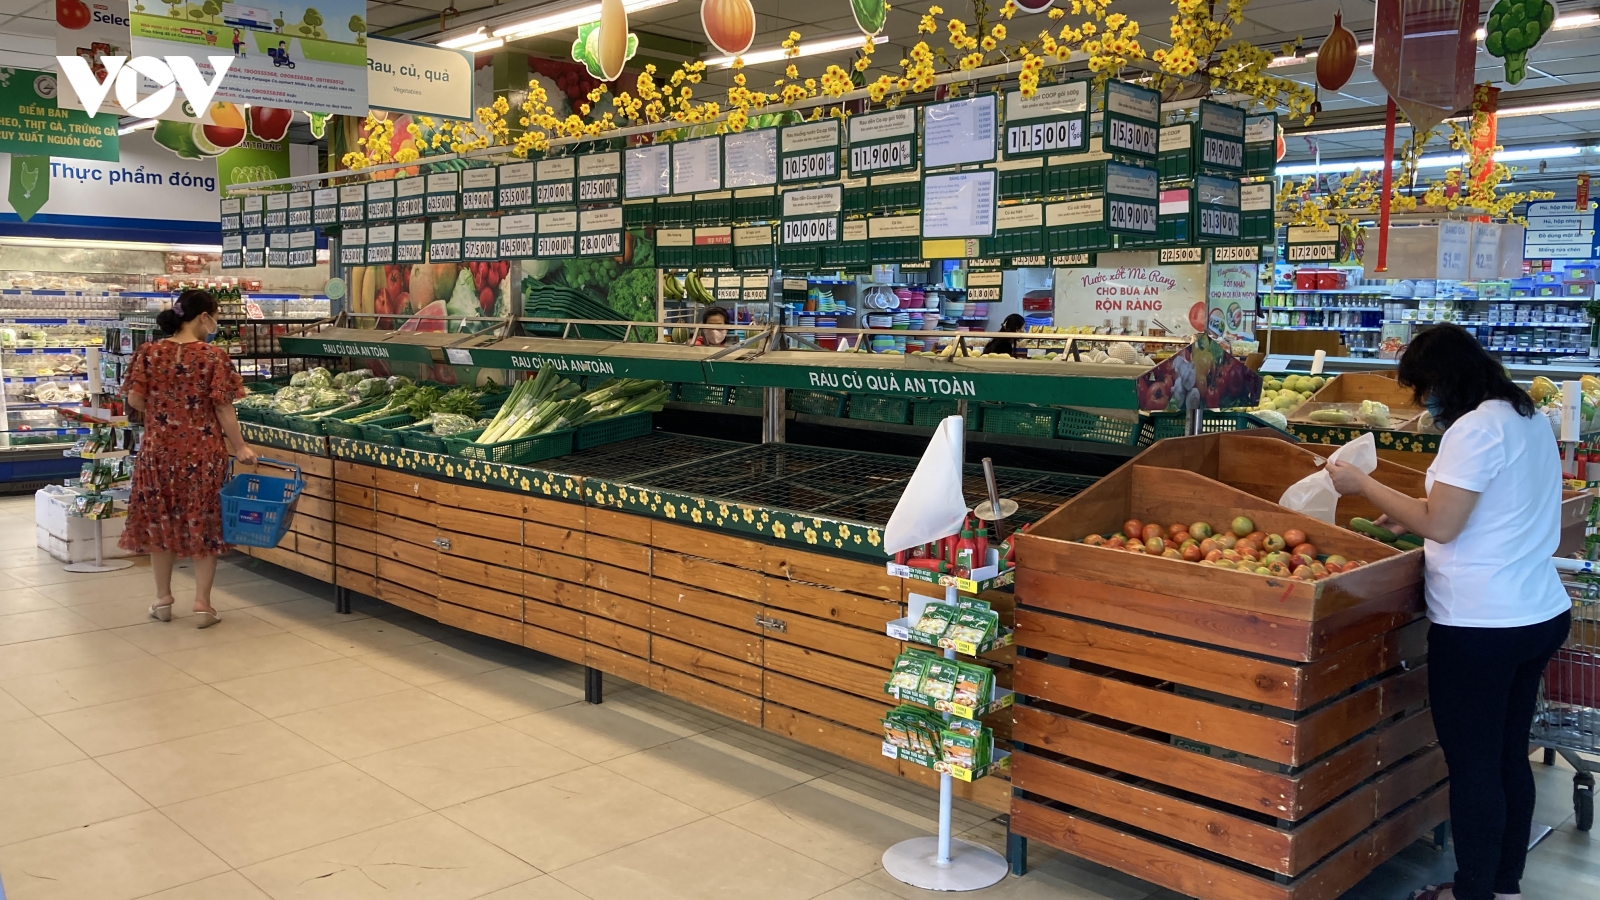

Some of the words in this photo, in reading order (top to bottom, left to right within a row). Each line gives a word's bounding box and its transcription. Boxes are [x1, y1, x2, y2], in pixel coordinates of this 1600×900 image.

[400, 63, 420, 80] củ,
[425, 69, 450, 82] quả
[393, 86, 422, 95] Vegetables
[1041, 92, 1057, 100] COOP
[19, 103, 45, 116] ĐIỂM
[24, 119, 46, 131] THỊT
[50, 121, 66, 133] GÀ,
[69, 123, 101, 135] TRỨNG
[104, 126, 117, 137] GÀ
[1011, 125, 1066, 148] 11.500
[1112, 122, 1149, 147] 15.300
[18, 130, 44, 143] XUẤT
[47, 133, 80, 146] NGUỒN
[83, 136, 103, 148] GỐC
[854, 146, 899, 167] 11.900
[1206, 140, 1235, 161] 19.900
[786, 157, 824, 175] 10.500
[50, 162, 102, 184] Thực
[109, 164, 162, 187] phẩm
[168, 170, 215, 192] đóng
[500, 189, 525, 203] 55.500
[538, 185, 565, 200] 27.000
[581, 181, 610, 196] 27.500
[464, 193, 487, 206] 39.900
[1112, 204, 1149, 228] 20.900
[1202, 210, 1232, 232] 31.300
[786, 221, 825, 239] 10.000
[465, 241, 490, 254] 57.500
[501, 238, 526, 253] 46.500
[539, 237, 566, 252] 51.000
[581, 233, 611, 251] 28.000
[1162, 250, 1193, 260] 22.500
[1216, 248, 1250, 259] 27.500
[1292, 246, 1326, 258] 17.200
[1081, 272, 1107, 288] Nước
[1128, 268, 1147, 280] Mè
[1149, 270, 1176, 291] Rang
[1096, 287, 1117, 296] CHO
[1120, 285, 1140, 296] BỮA
[1143, 285, 1159, 296] ĂN
[1095, 298, 1122, 313] RỘN
[1126, 298, 1162, 311] RÀNG
[322, 344, 336, 354] RAU
[336, 342, 346, 355] CỦ
[346, 343, 361, 355] QUẢ
[361, 346, 371, 356] AN
[370, 345, 389, 358] TOÀN
[511, 356, 531, 369] RAU
[532, 355, 544, 369] CỦ
[571, 360, 585, 372] AN
[585, 359, 614, 375] TOÀN
[809, 372, 839, 388] RAU
[842, 371, 862, 389] CỦ
[866, 373, 900, 392] QUẢ
[905, 378, 926, 394] AN
[928, 376, 975, 396] TOÀN
